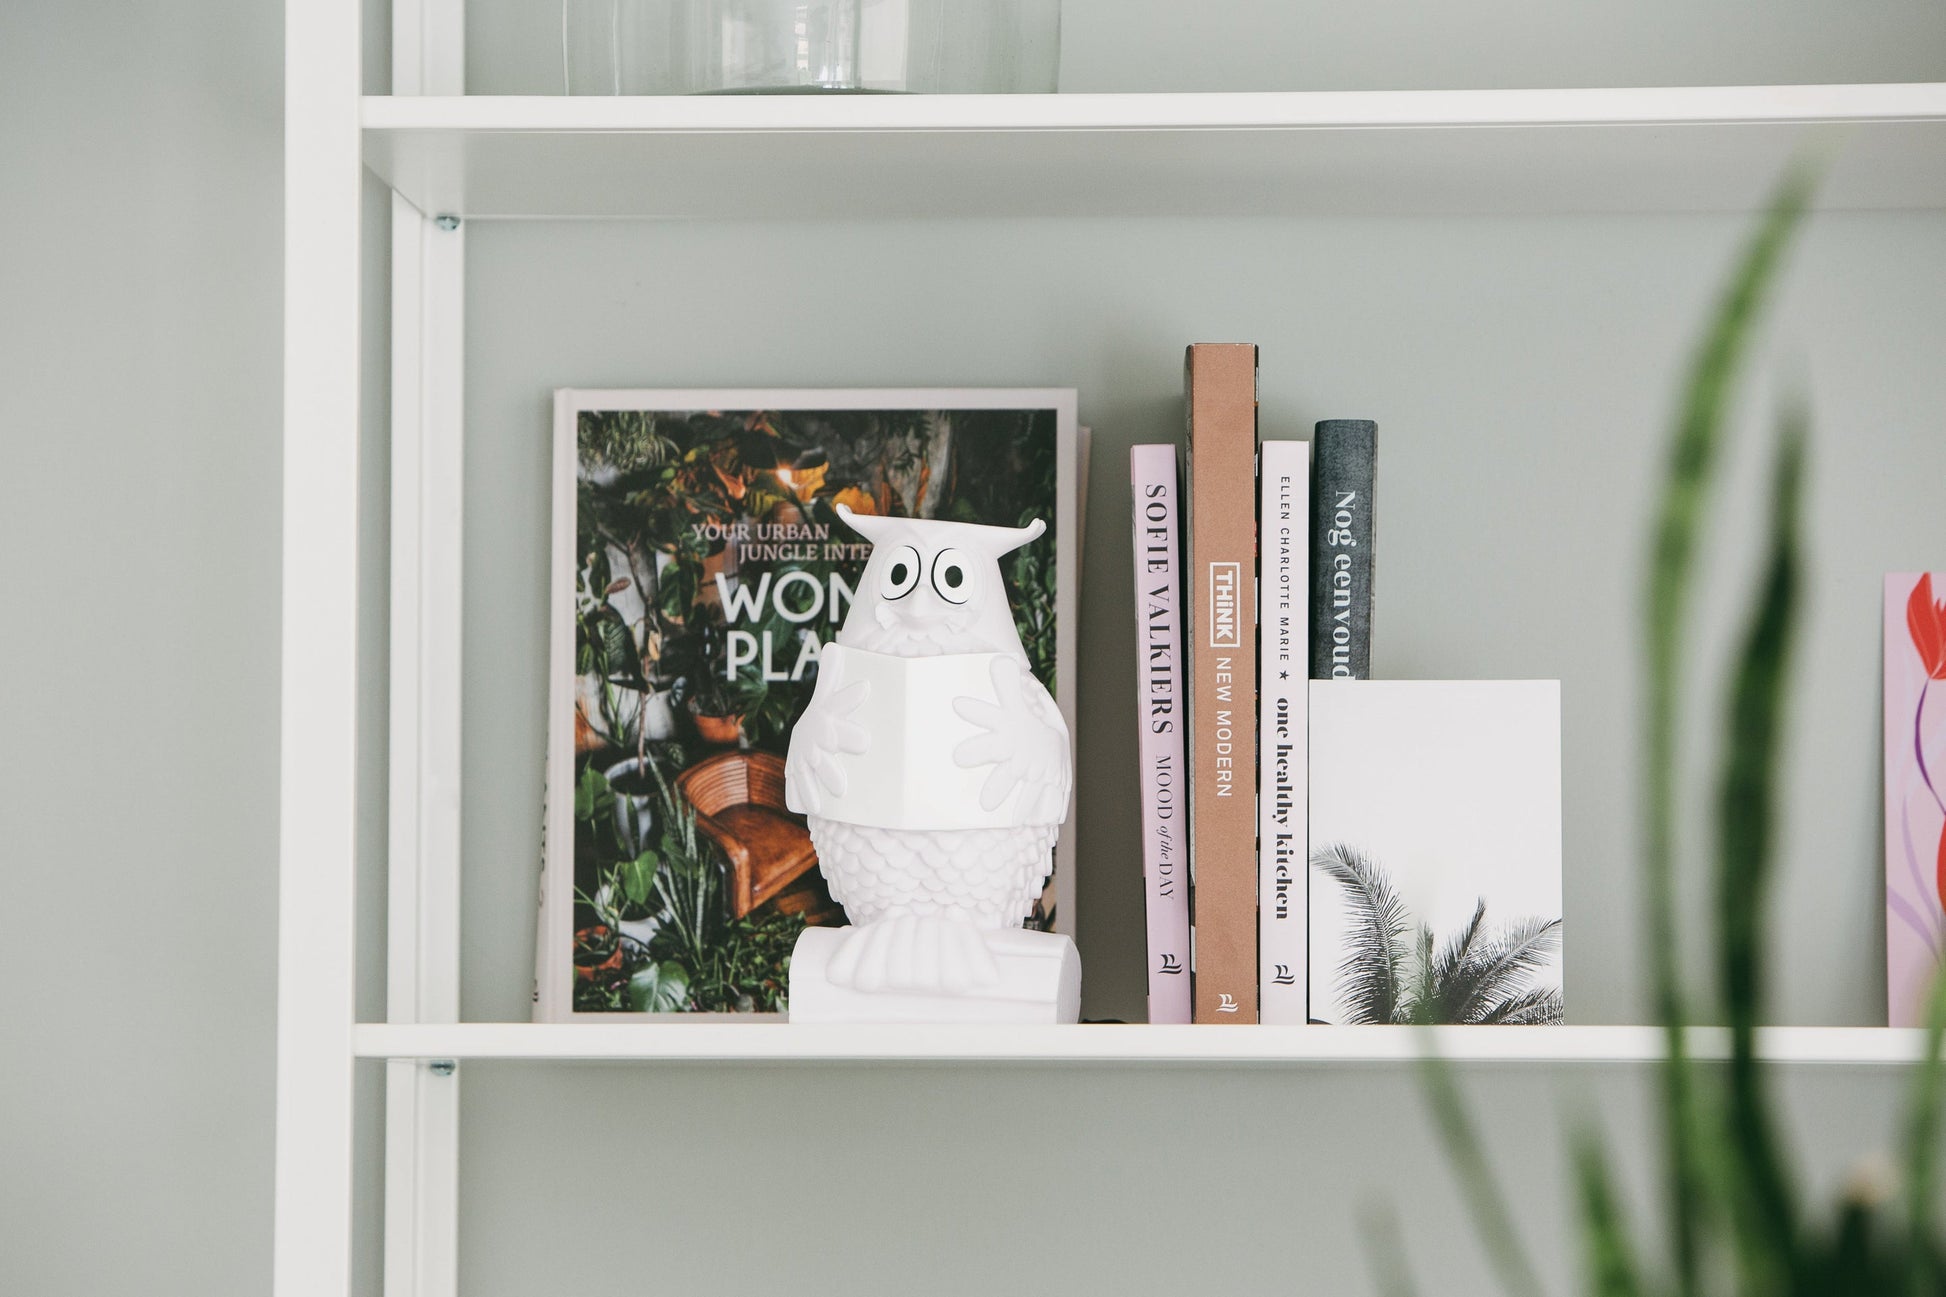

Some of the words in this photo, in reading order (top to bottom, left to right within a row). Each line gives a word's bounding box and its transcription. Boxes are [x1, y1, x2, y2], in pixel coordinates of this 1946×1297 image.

[1280, 476, 1290, 520] ELLEN
[1328, 490, 1356, 547] Nog
[691, 523, 750, 541] YOUR
[757, 523, 830, 541] URBAN
[739, 543, 818, 564] JUNGLE
[1145, 484, 1169, 574] SOFIE
[1280, 527, 1290, 609] CHARLOTTE
[1279, 617, 1290, 661] MARIE
[1332, 553, 1356, 680] eenvoud
[727, 630, 842, 682] PLA
[1148, 584, 1174, 734] VALKIERS
[1216, 657, 1232, 702] NEW
[1276, 697, 1289, 738] one
[1216, 710, 1233, 797] MODERN
[1156, 755, 1174, 820] MOOD
[1272, 744, 1294, 828] healthy
[1156, 825, 1172, 842] of
[1160, 841, 1172, 859] the
[1159, 863, 1174, 900] DAY
[1276, 834, 1294, 919] kitchen
